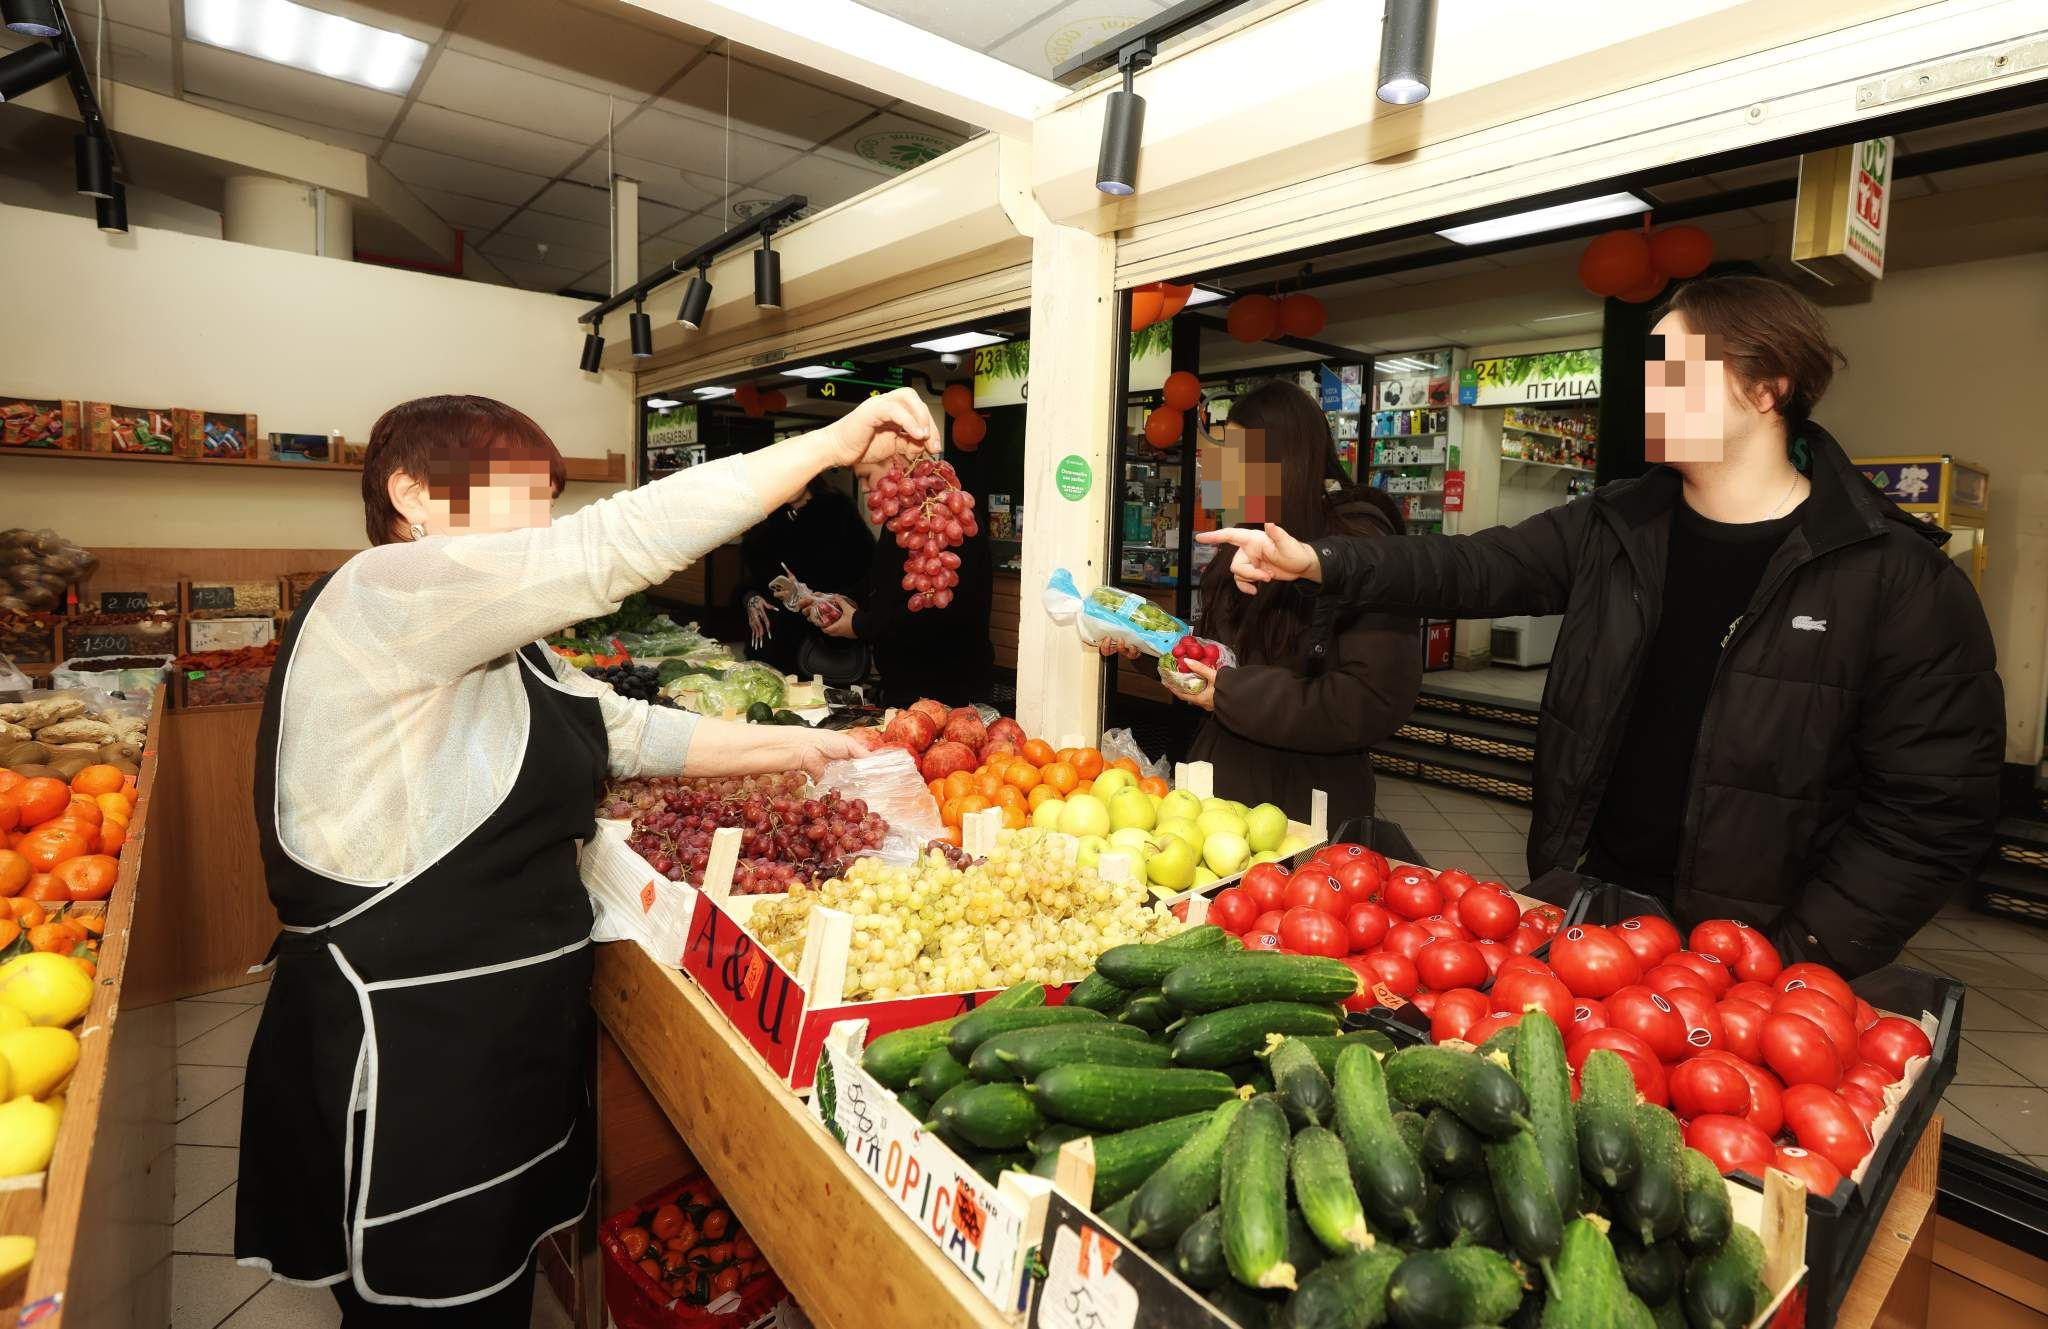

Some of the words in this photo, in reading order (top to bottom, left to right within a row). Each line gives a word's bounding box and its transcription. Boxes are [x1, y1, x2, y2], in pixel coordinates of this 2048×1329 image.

[1476, 361, 1498, 381] 24
[1525, 379, 1599, 400] ПТИЦА
[81, 636, 129, 652] 1500
